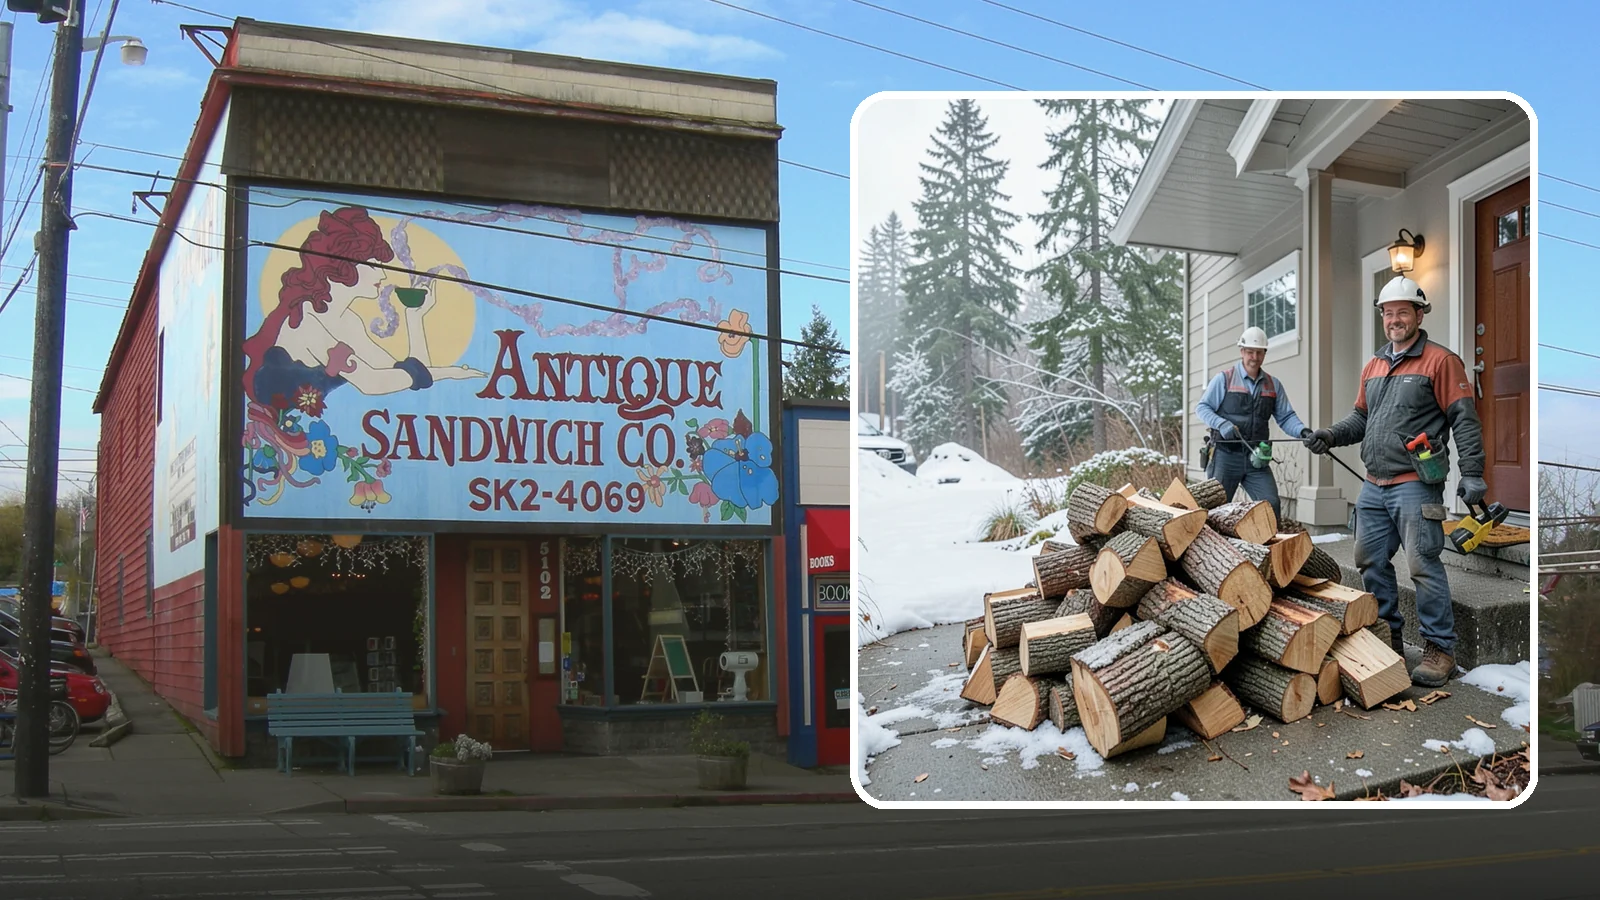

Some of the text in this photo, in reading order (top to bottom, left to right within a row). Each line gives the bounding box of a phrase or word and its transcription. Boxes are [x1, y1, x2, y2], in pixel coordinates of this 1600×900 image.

[476, 329, 723, 420] ANTIQUE
[361, 409, 685, 468] SANDWICH CO.
[469, 477, 645, 513] SK2-4069
[540, 541, 551, 599] 5102
[809, 555, 834, 568] BOOKS
